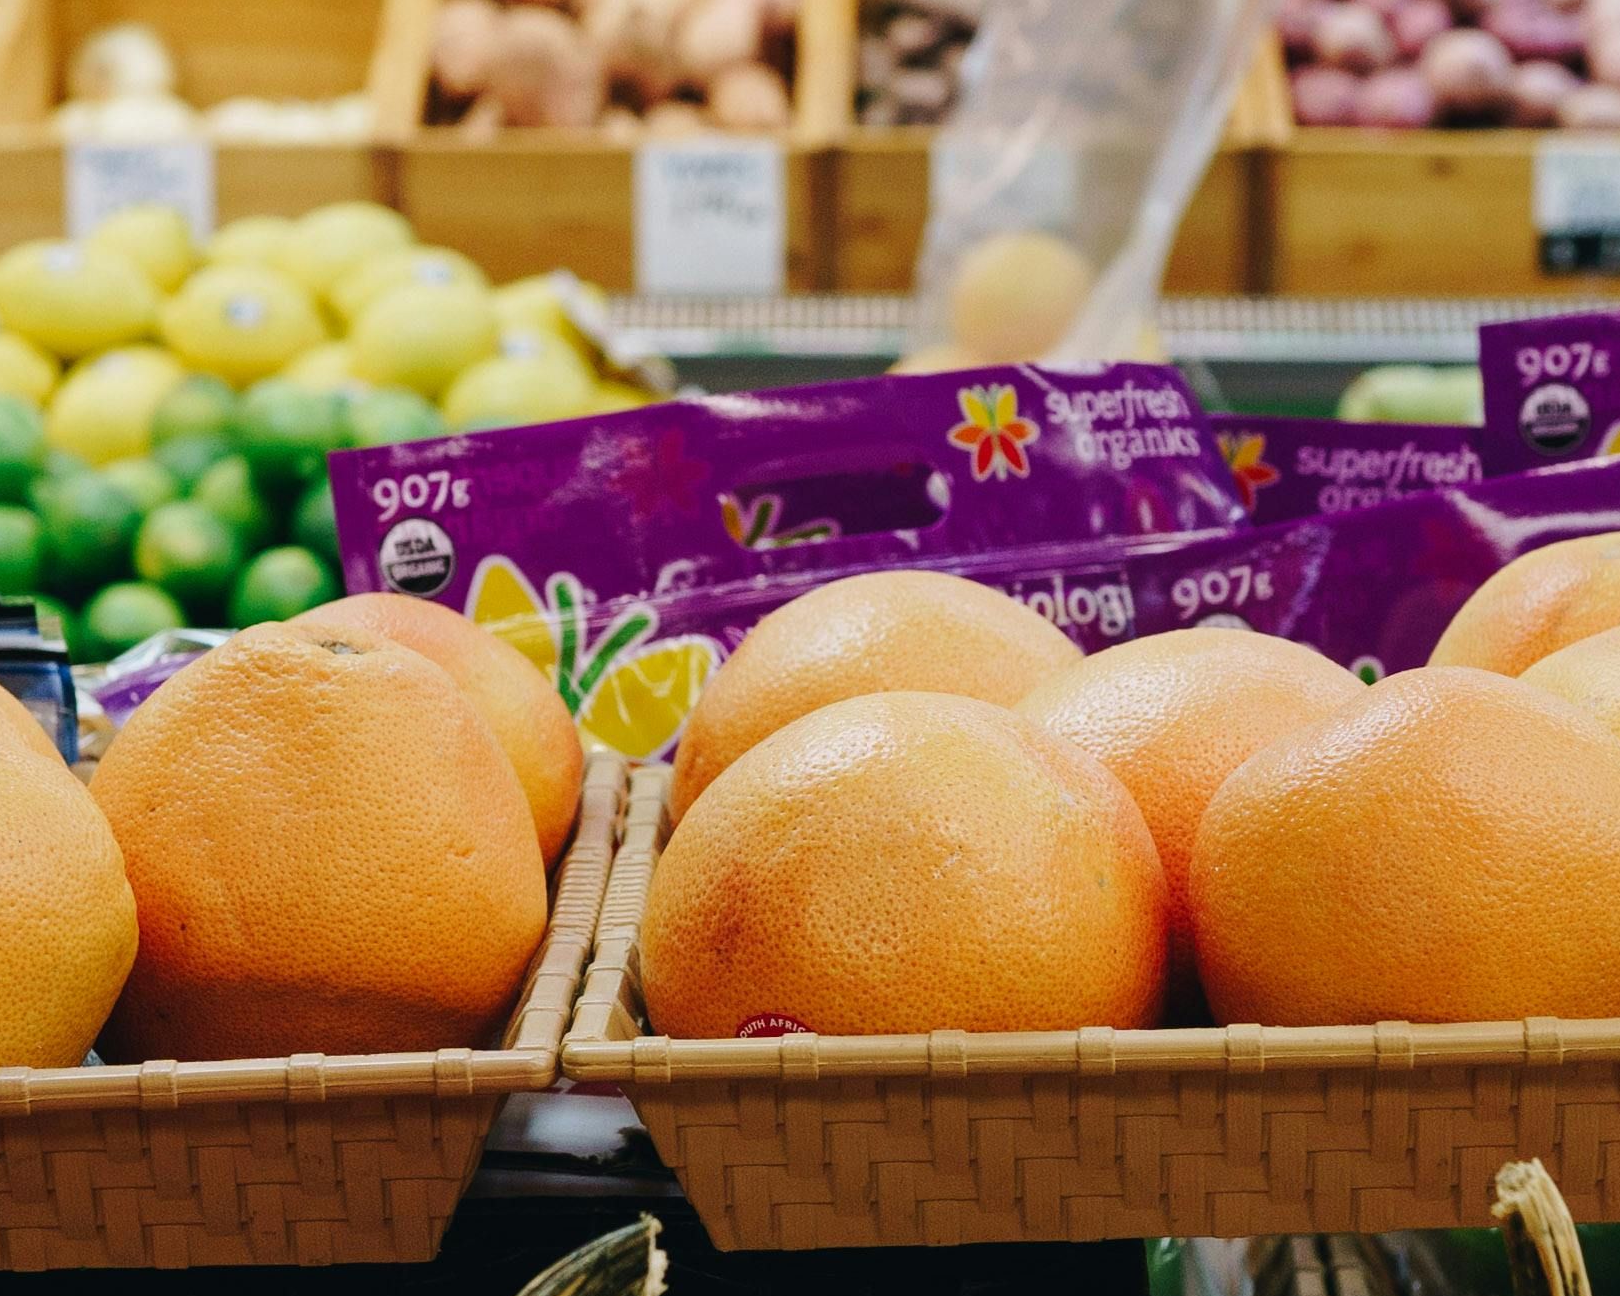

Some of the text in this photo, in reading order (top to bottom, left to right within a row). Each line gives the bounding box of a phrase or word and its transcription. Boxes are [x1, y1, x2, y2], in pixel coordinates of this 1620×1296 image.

[1516, 341, 1611, 387] 907g
[1044, 379, 1191, 429] superfresh
[1074, 420, 1201, 471] organics
[1296, 441, 1483, 493] superfresh
[373, 470, 473, 522] 907g
[1171, 565, 1274, 620] 907g
[739, 1018, 806, 1038] OUTH AFRIC
